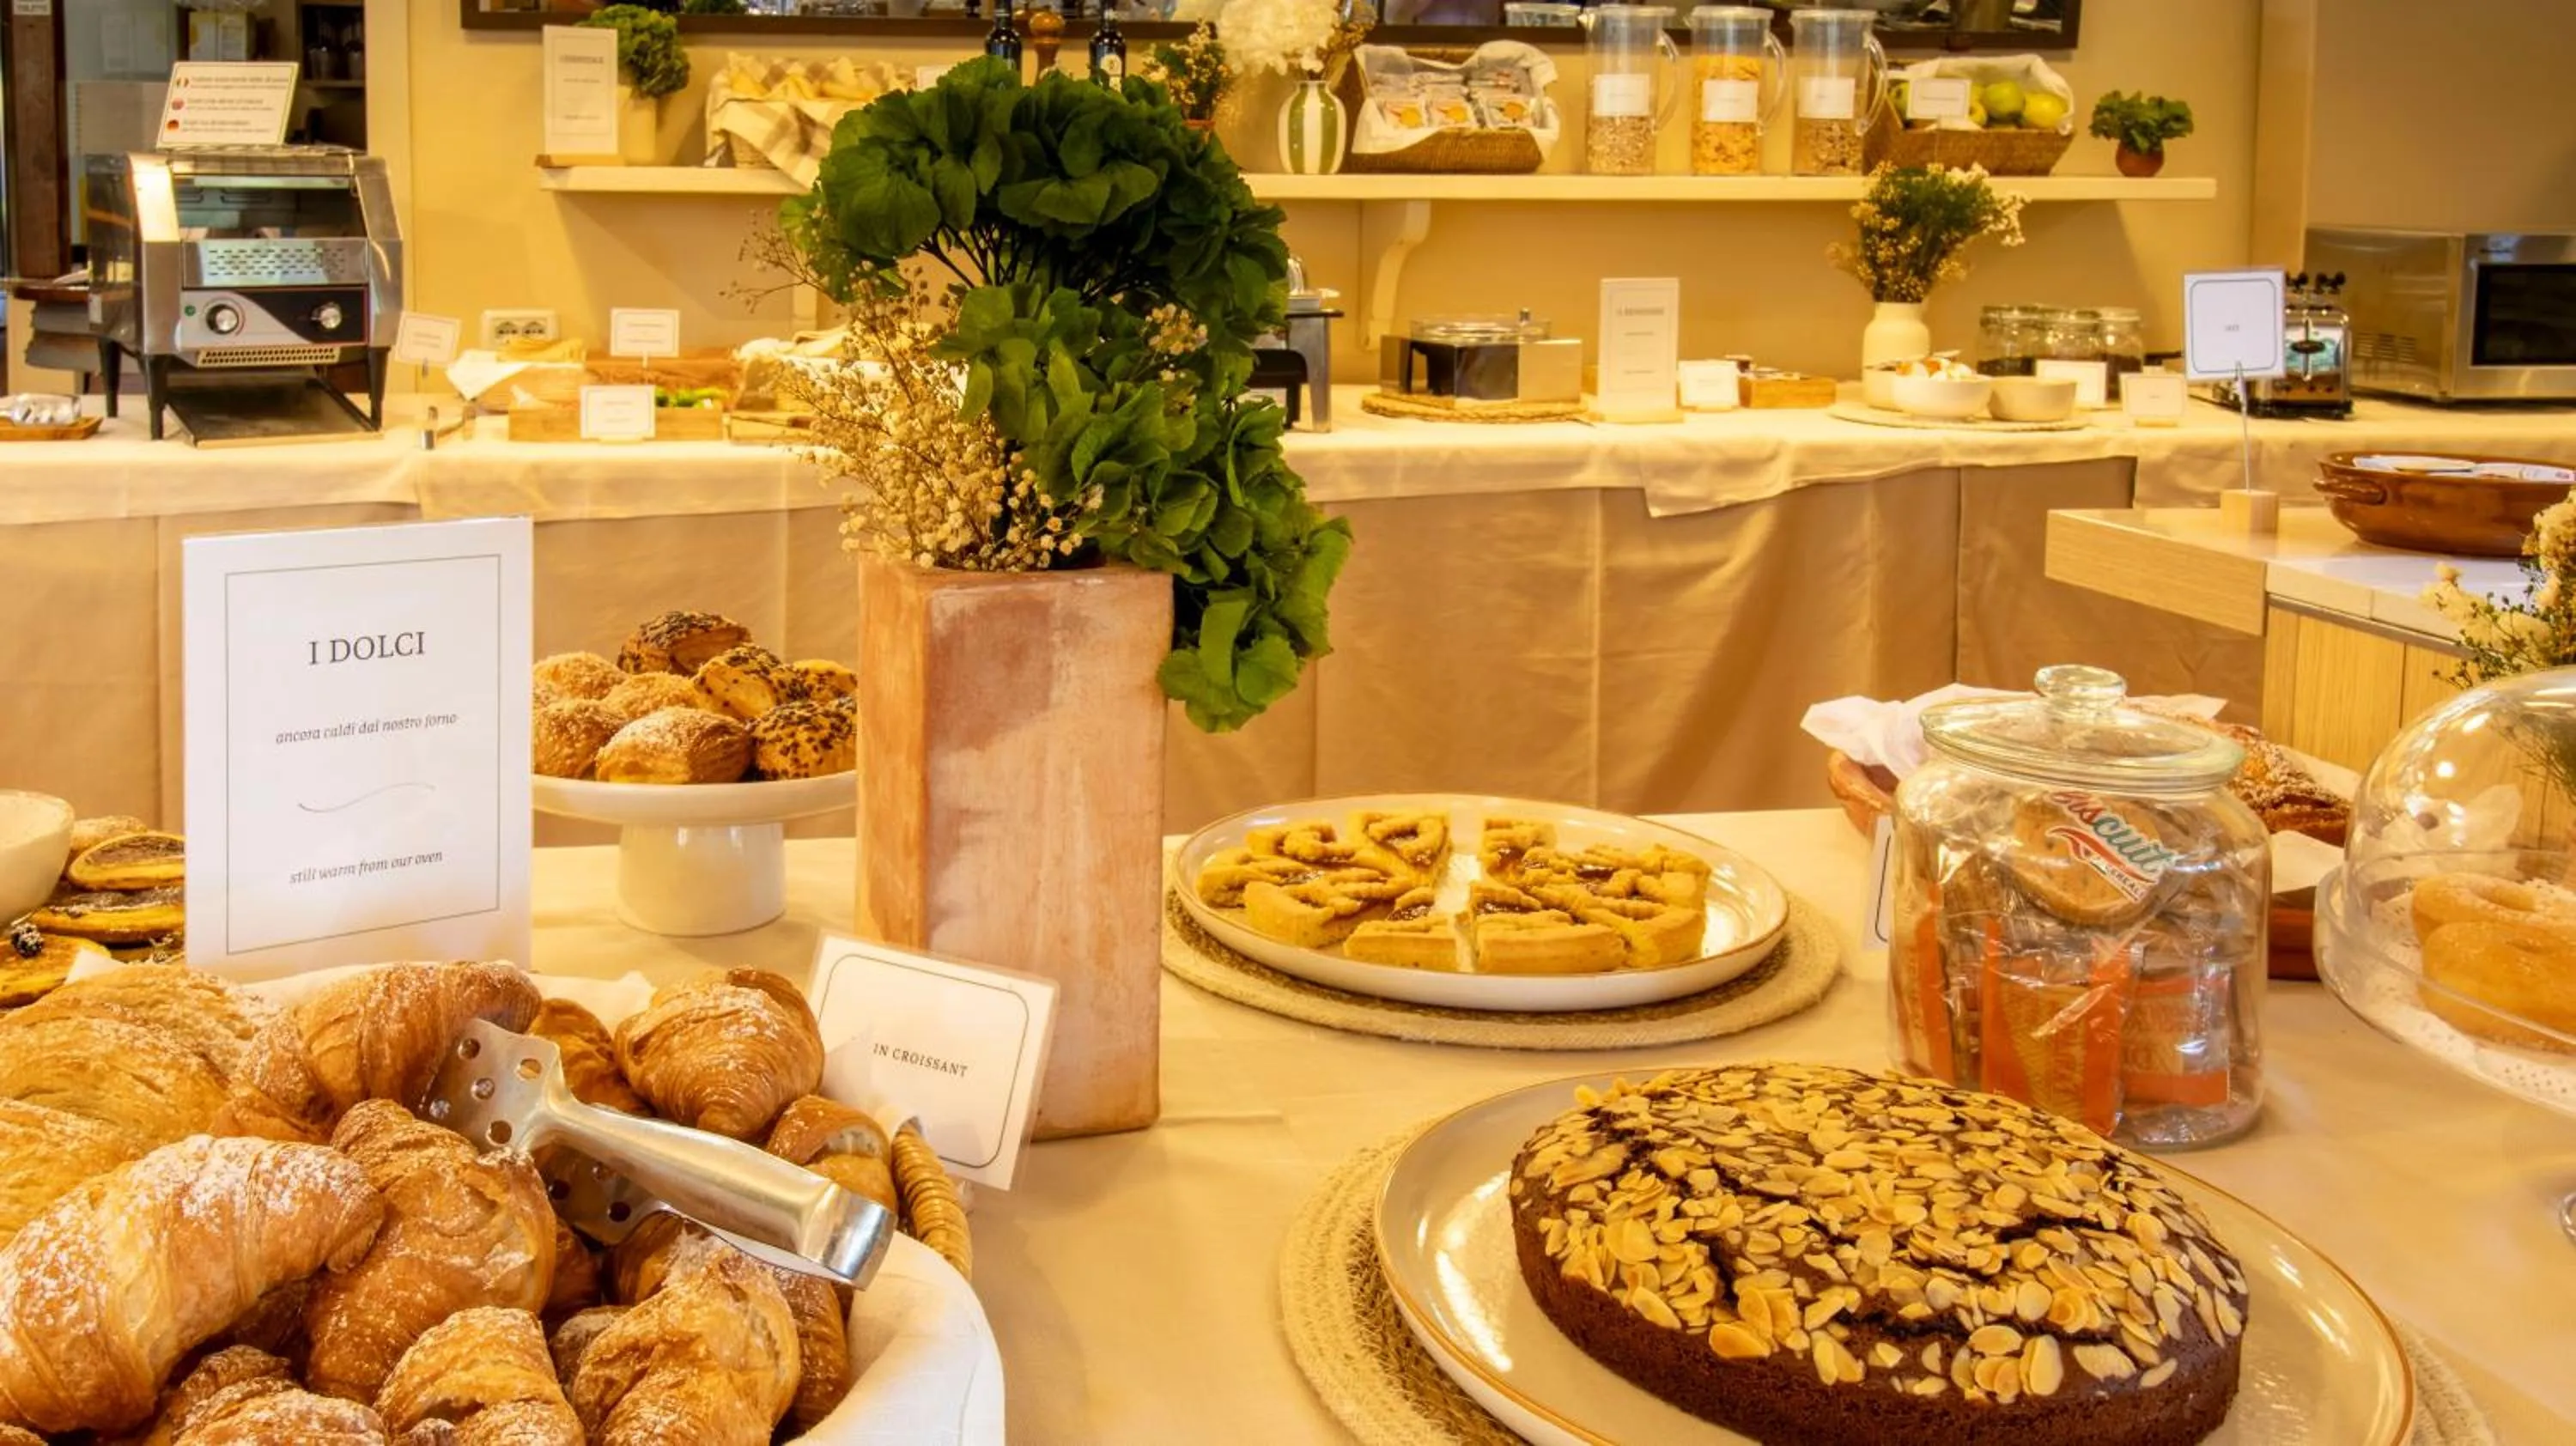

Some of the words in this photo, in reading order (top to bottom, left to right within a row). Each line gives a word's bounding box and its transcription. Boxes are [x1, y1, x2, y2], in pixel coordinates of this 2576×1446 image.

[309, 641, 319, 665] I
[329, 630, 427, 665] DOLCI
[276, 727, 320, 744] ancora
[324, 721, 355, 738] caldi
[358, 718, 380, 735] dal
[382, 716, 422, 732] nostro
[424, 713, 459, 730] forno
[289, 867, 317, 884] still
[319, 864, 356, 879] warm
[358, 859, 389, 878] from
[391, 855, 413, 869] our
[414, 851, 443, 866] oven
[872, 1042, 890, 1057] IN
[892, 1048, 969, 1078] CROISSANT
